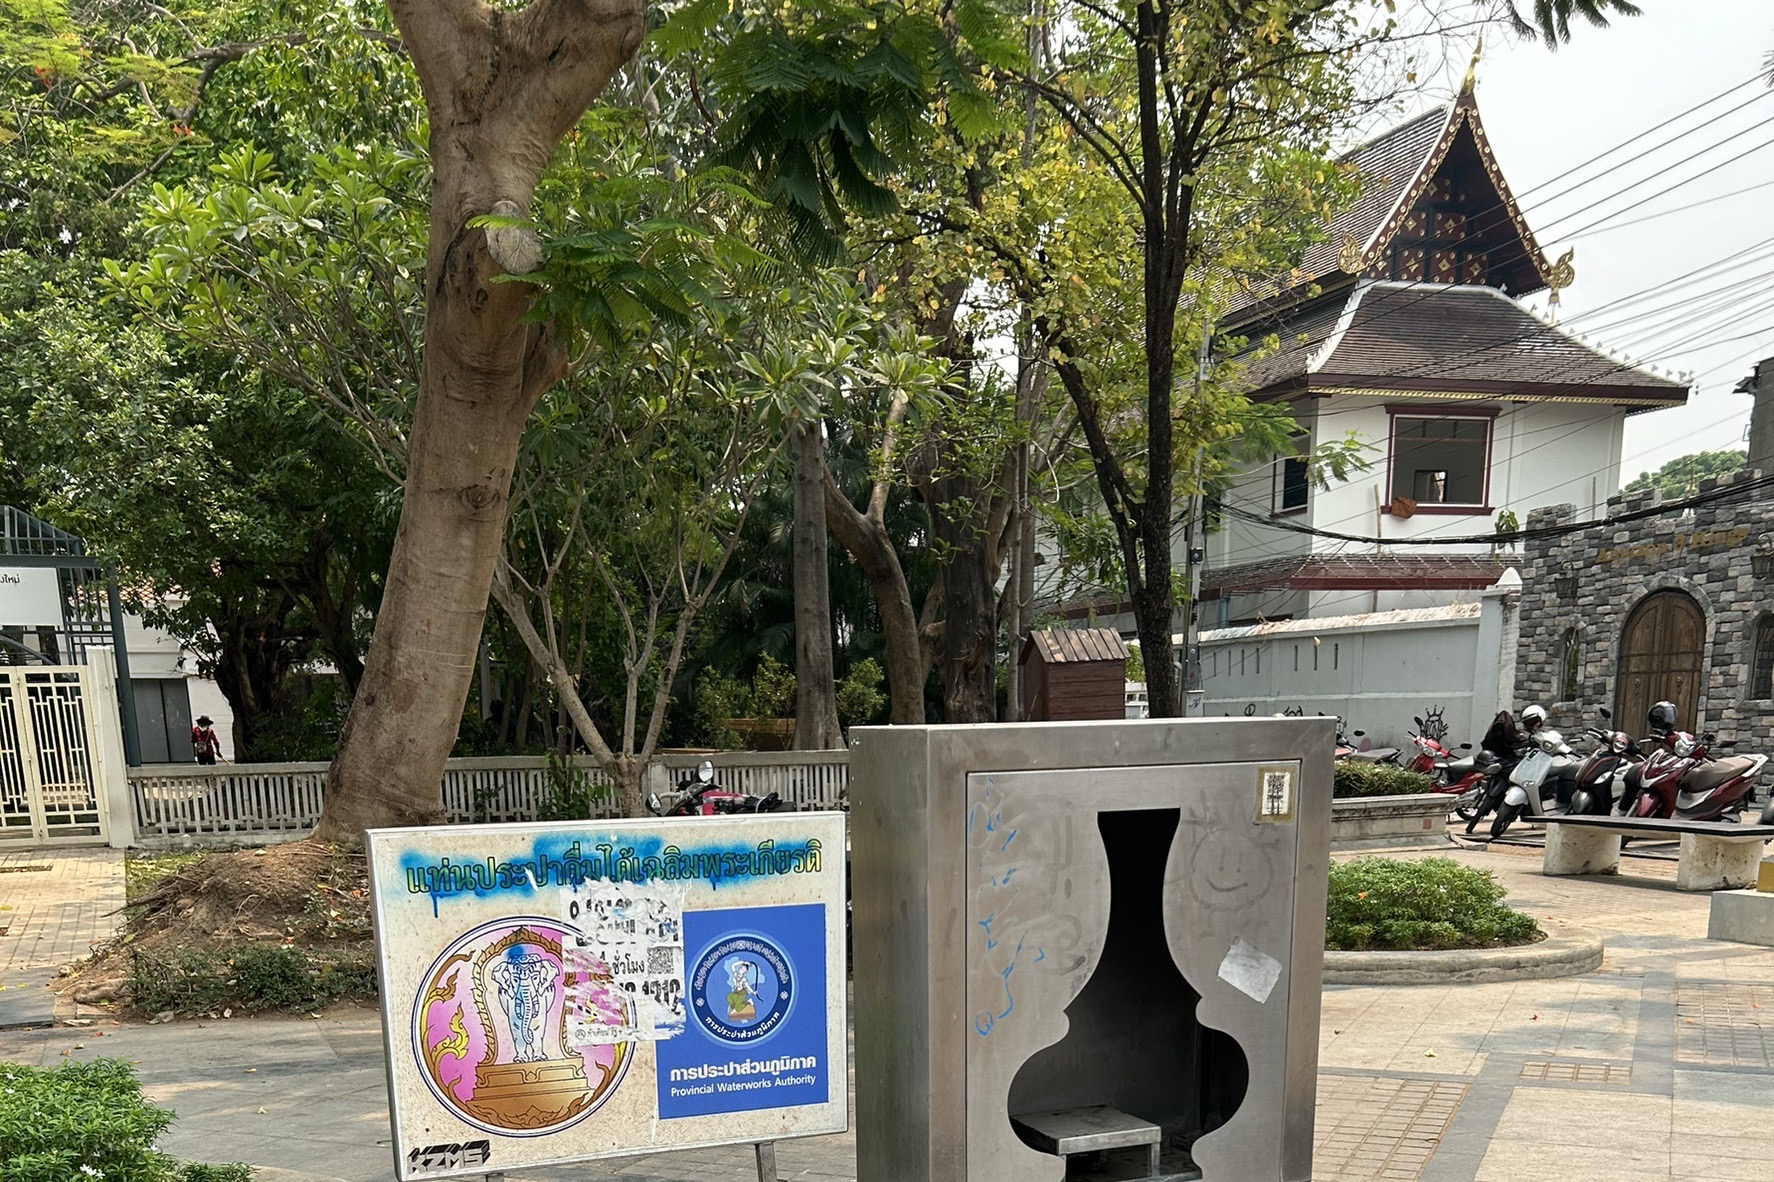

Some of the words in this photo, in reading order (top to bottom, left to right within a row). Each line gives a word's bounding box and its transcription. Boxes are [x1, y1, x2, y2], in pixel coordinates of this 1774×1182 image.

[670, 1055, 816, 1082] การประปาส่วนภูมิภาค
[671, 1085, 714, 1097] Provincial
[717, 1079, 772, 1093] Waterworks
[775, 1074, 816, 1087] Authority
